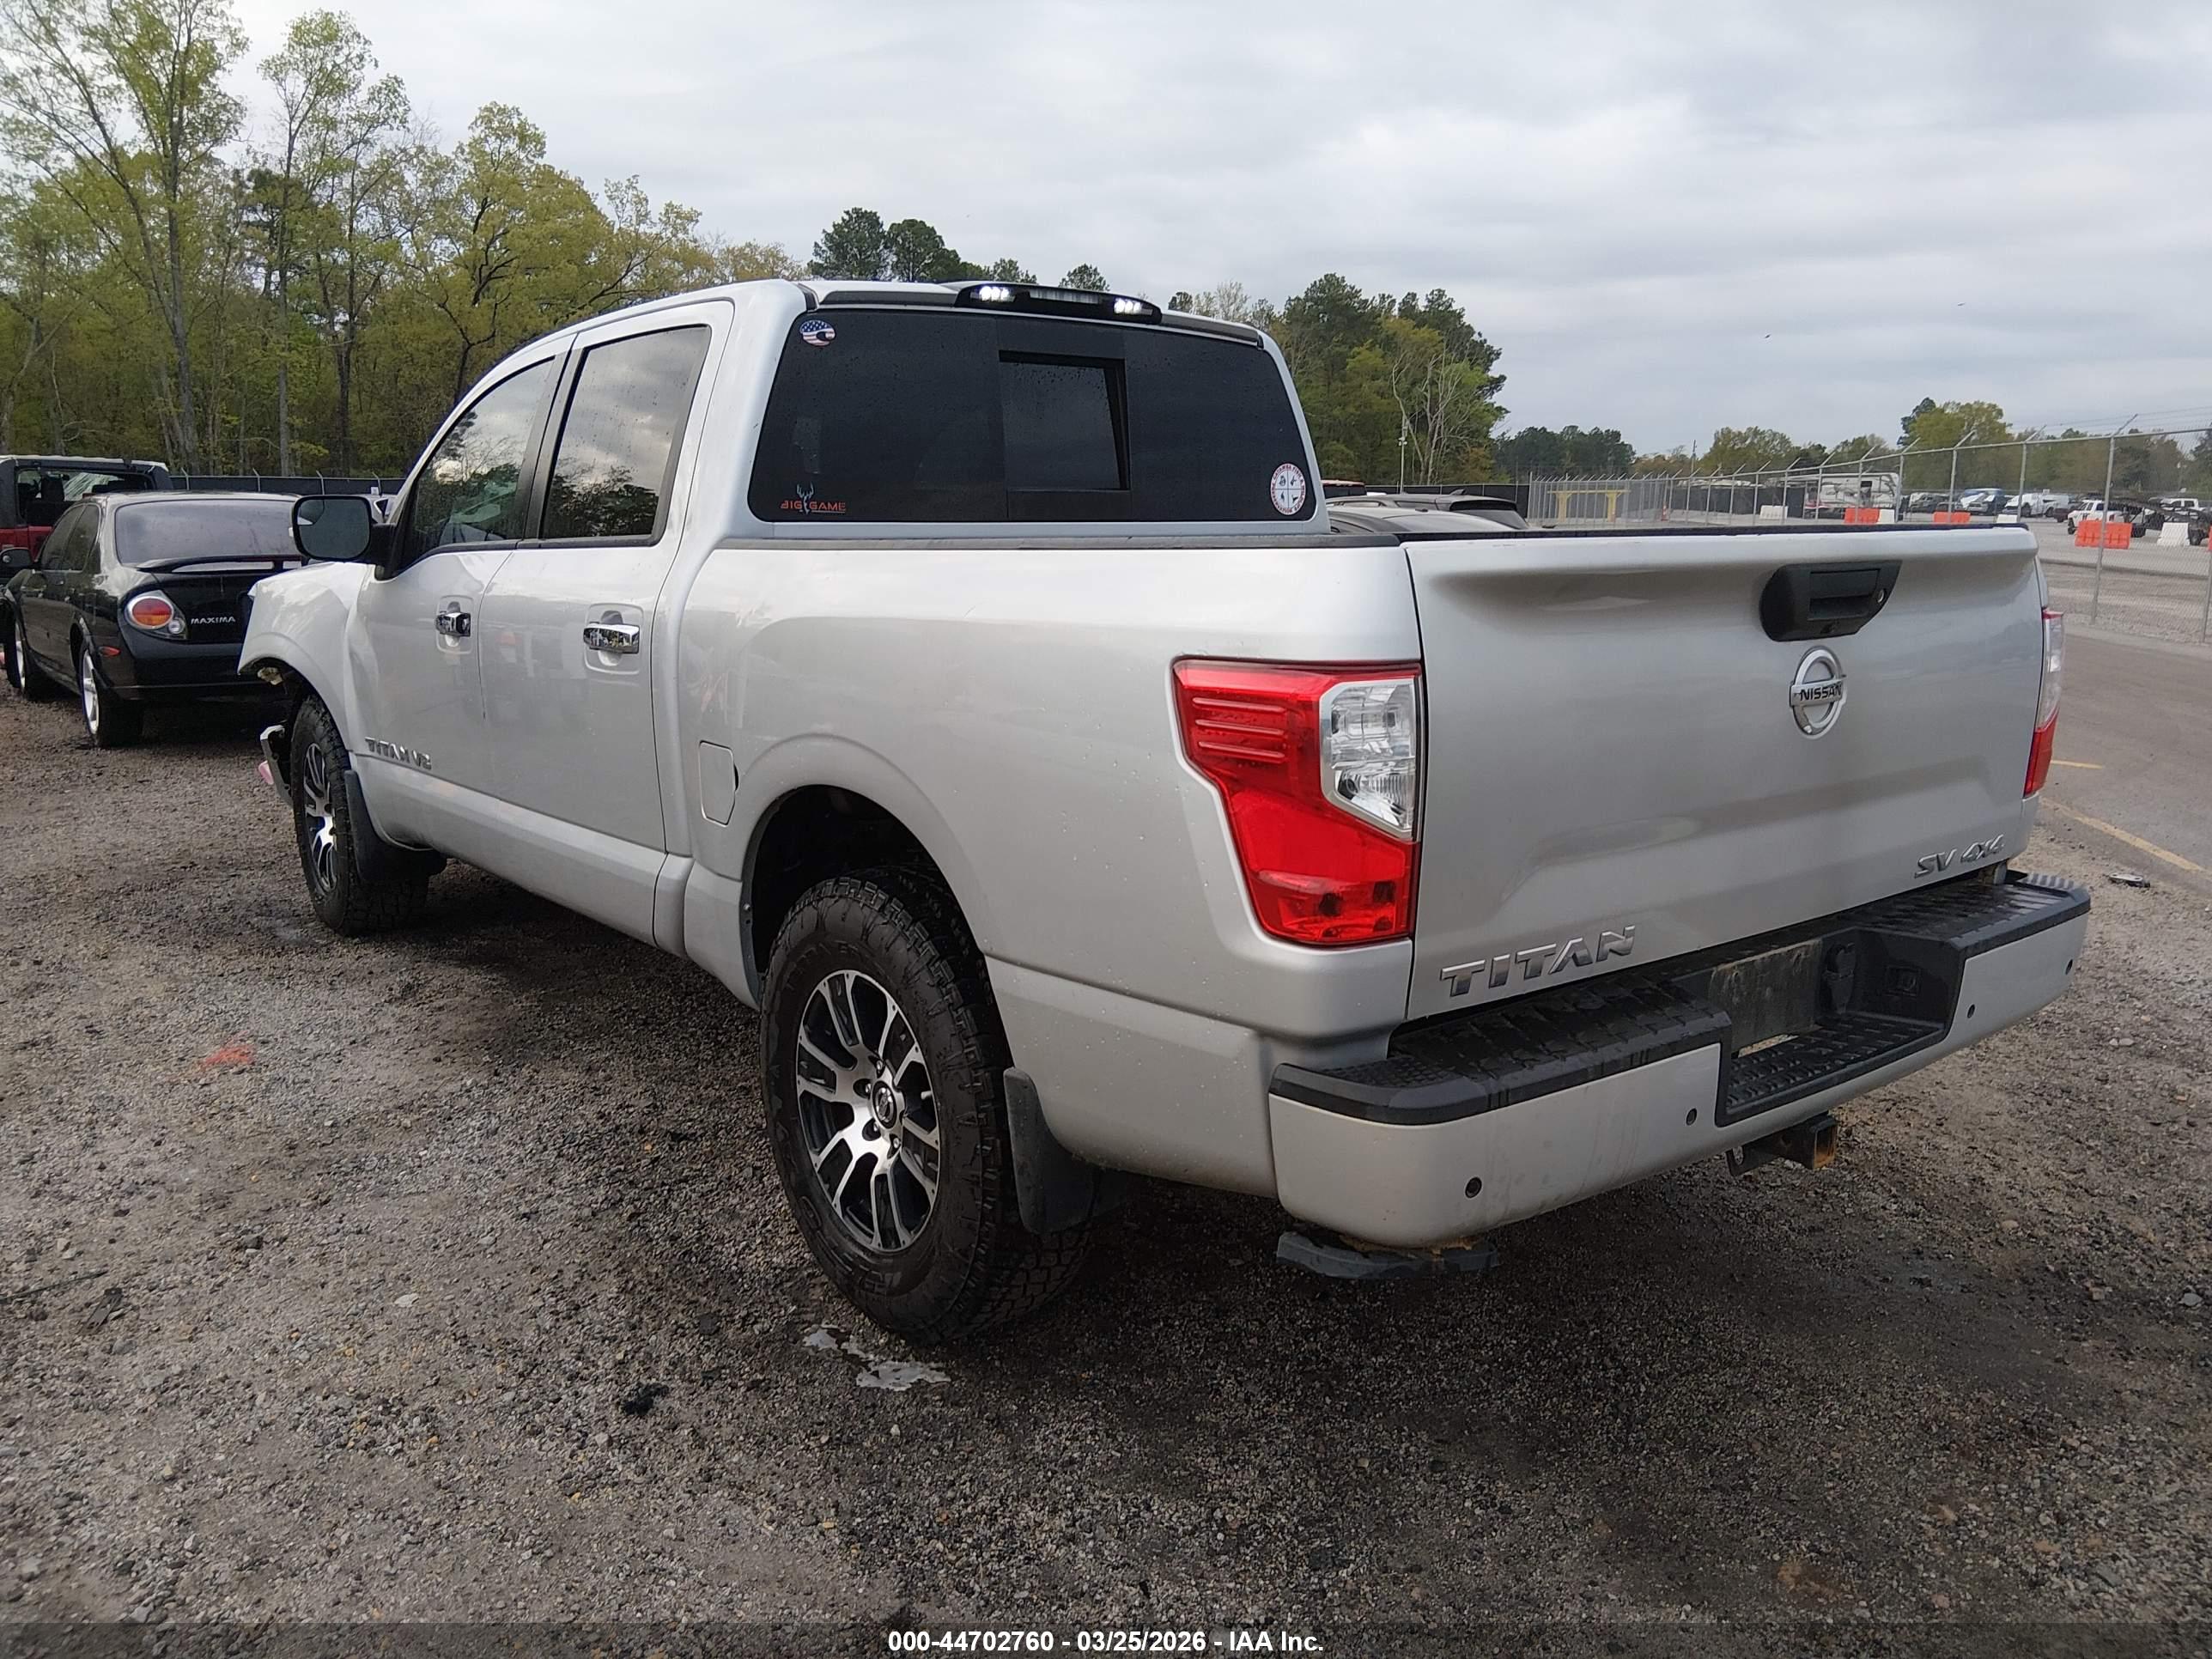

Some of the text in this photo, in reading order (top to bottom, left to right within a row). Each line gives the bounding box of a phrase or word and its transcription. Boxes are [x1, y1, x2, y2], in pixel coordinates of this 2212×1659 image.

[781, 500, 847, 511] BIG GAME
[191, 616, 236, 625] MAXIMA
[1800, 681, 1843, 702] NISSAN
[1913, 848, 1958, 879] SV
[1439, 925, 1636, 998] TITAN
